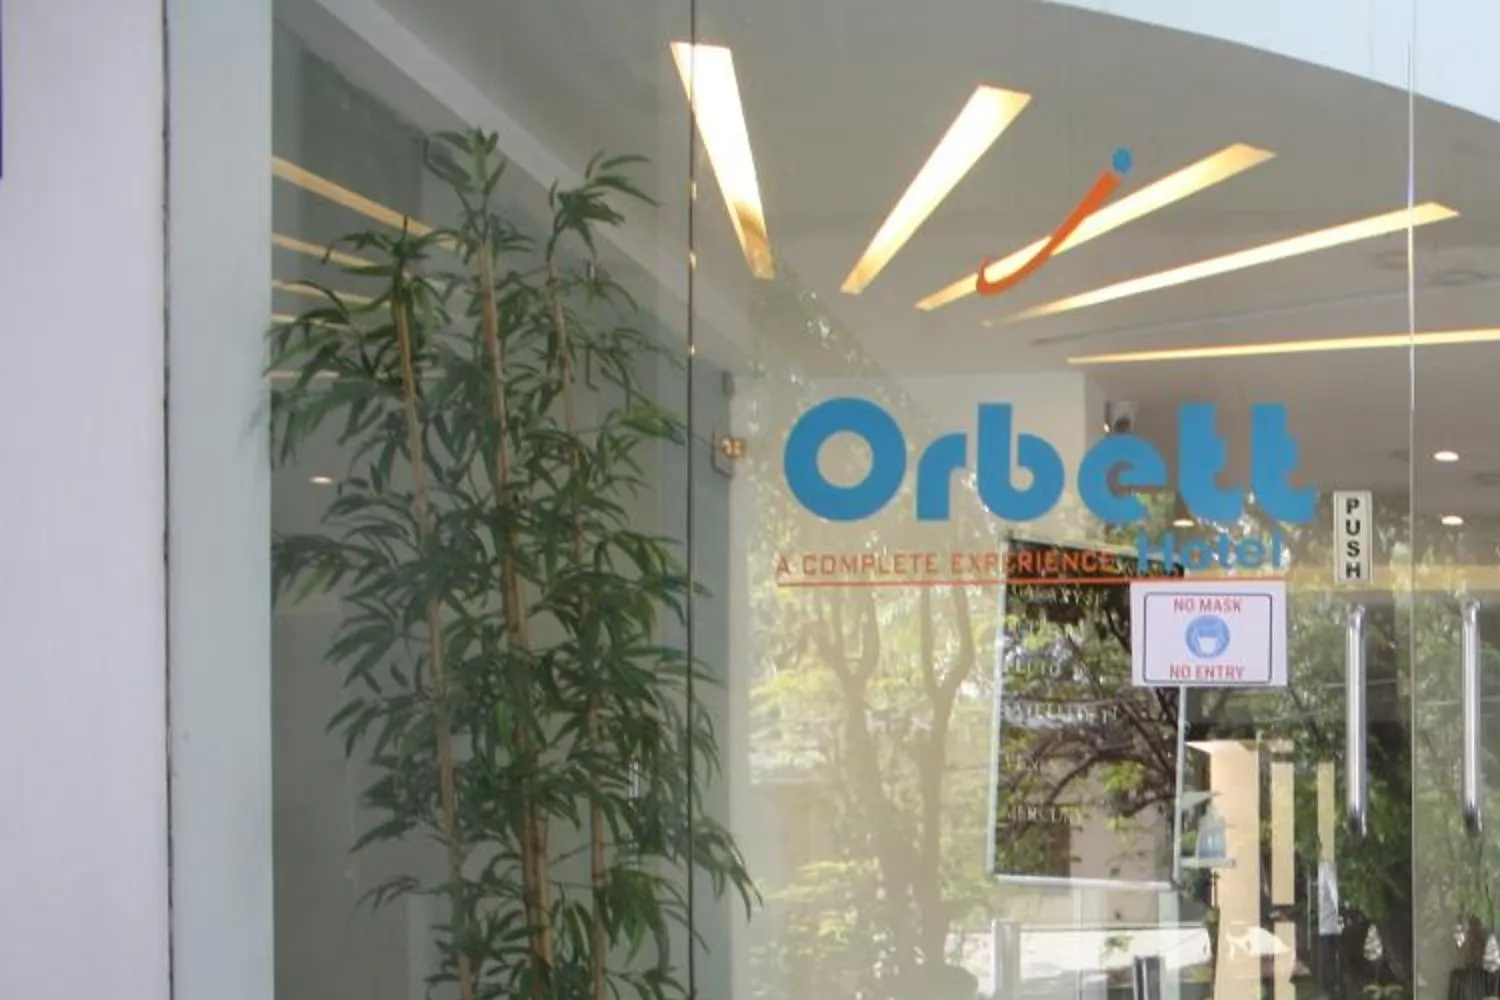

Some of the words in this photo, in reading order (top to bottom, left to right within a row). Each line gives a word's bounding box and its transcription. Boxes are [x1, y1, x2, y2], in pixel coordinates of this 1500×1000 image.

[783, 397, 1316, 523] Orbett
[1136, 529, 1284, 572] Hotel
[1345, 497, 1360, 579] PUSH
[776, 553, 793, 576] A
[802, 551, 940, 577] COMPLETE
[951, 550, 1115, 575] EXPERIENCE
[1173, 598, 1194, 612] NO
[1200, 597, 1241, 612] MASK
[1169, 665, 1194, 679] NO
[1196, 664, 1244, 679] ENTRY
